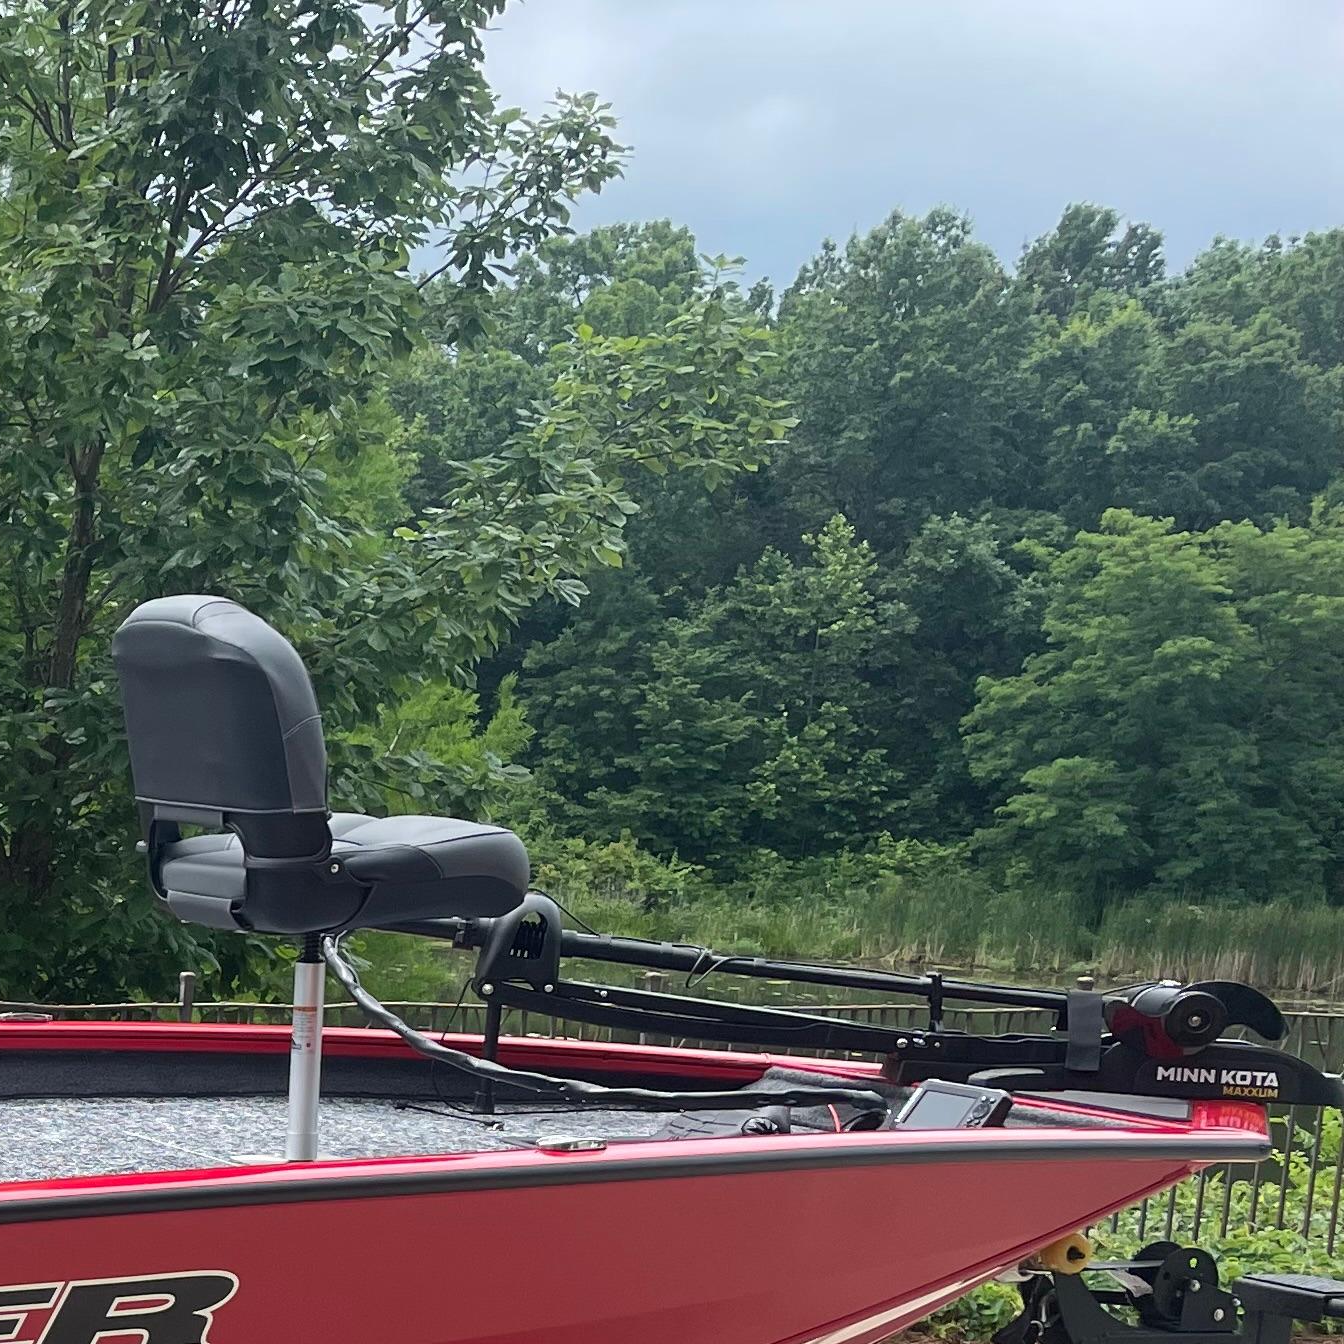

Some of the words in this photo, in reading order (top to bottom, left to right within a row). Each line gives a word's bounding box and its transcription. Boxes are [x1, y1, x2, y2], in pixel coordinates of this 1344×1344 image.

[1156, 1066, 1216, 1083] MINN
[1220, 1070, 1278, 1087] KOTA
[1223, 1086, 1278, 1098] MAXXUM
